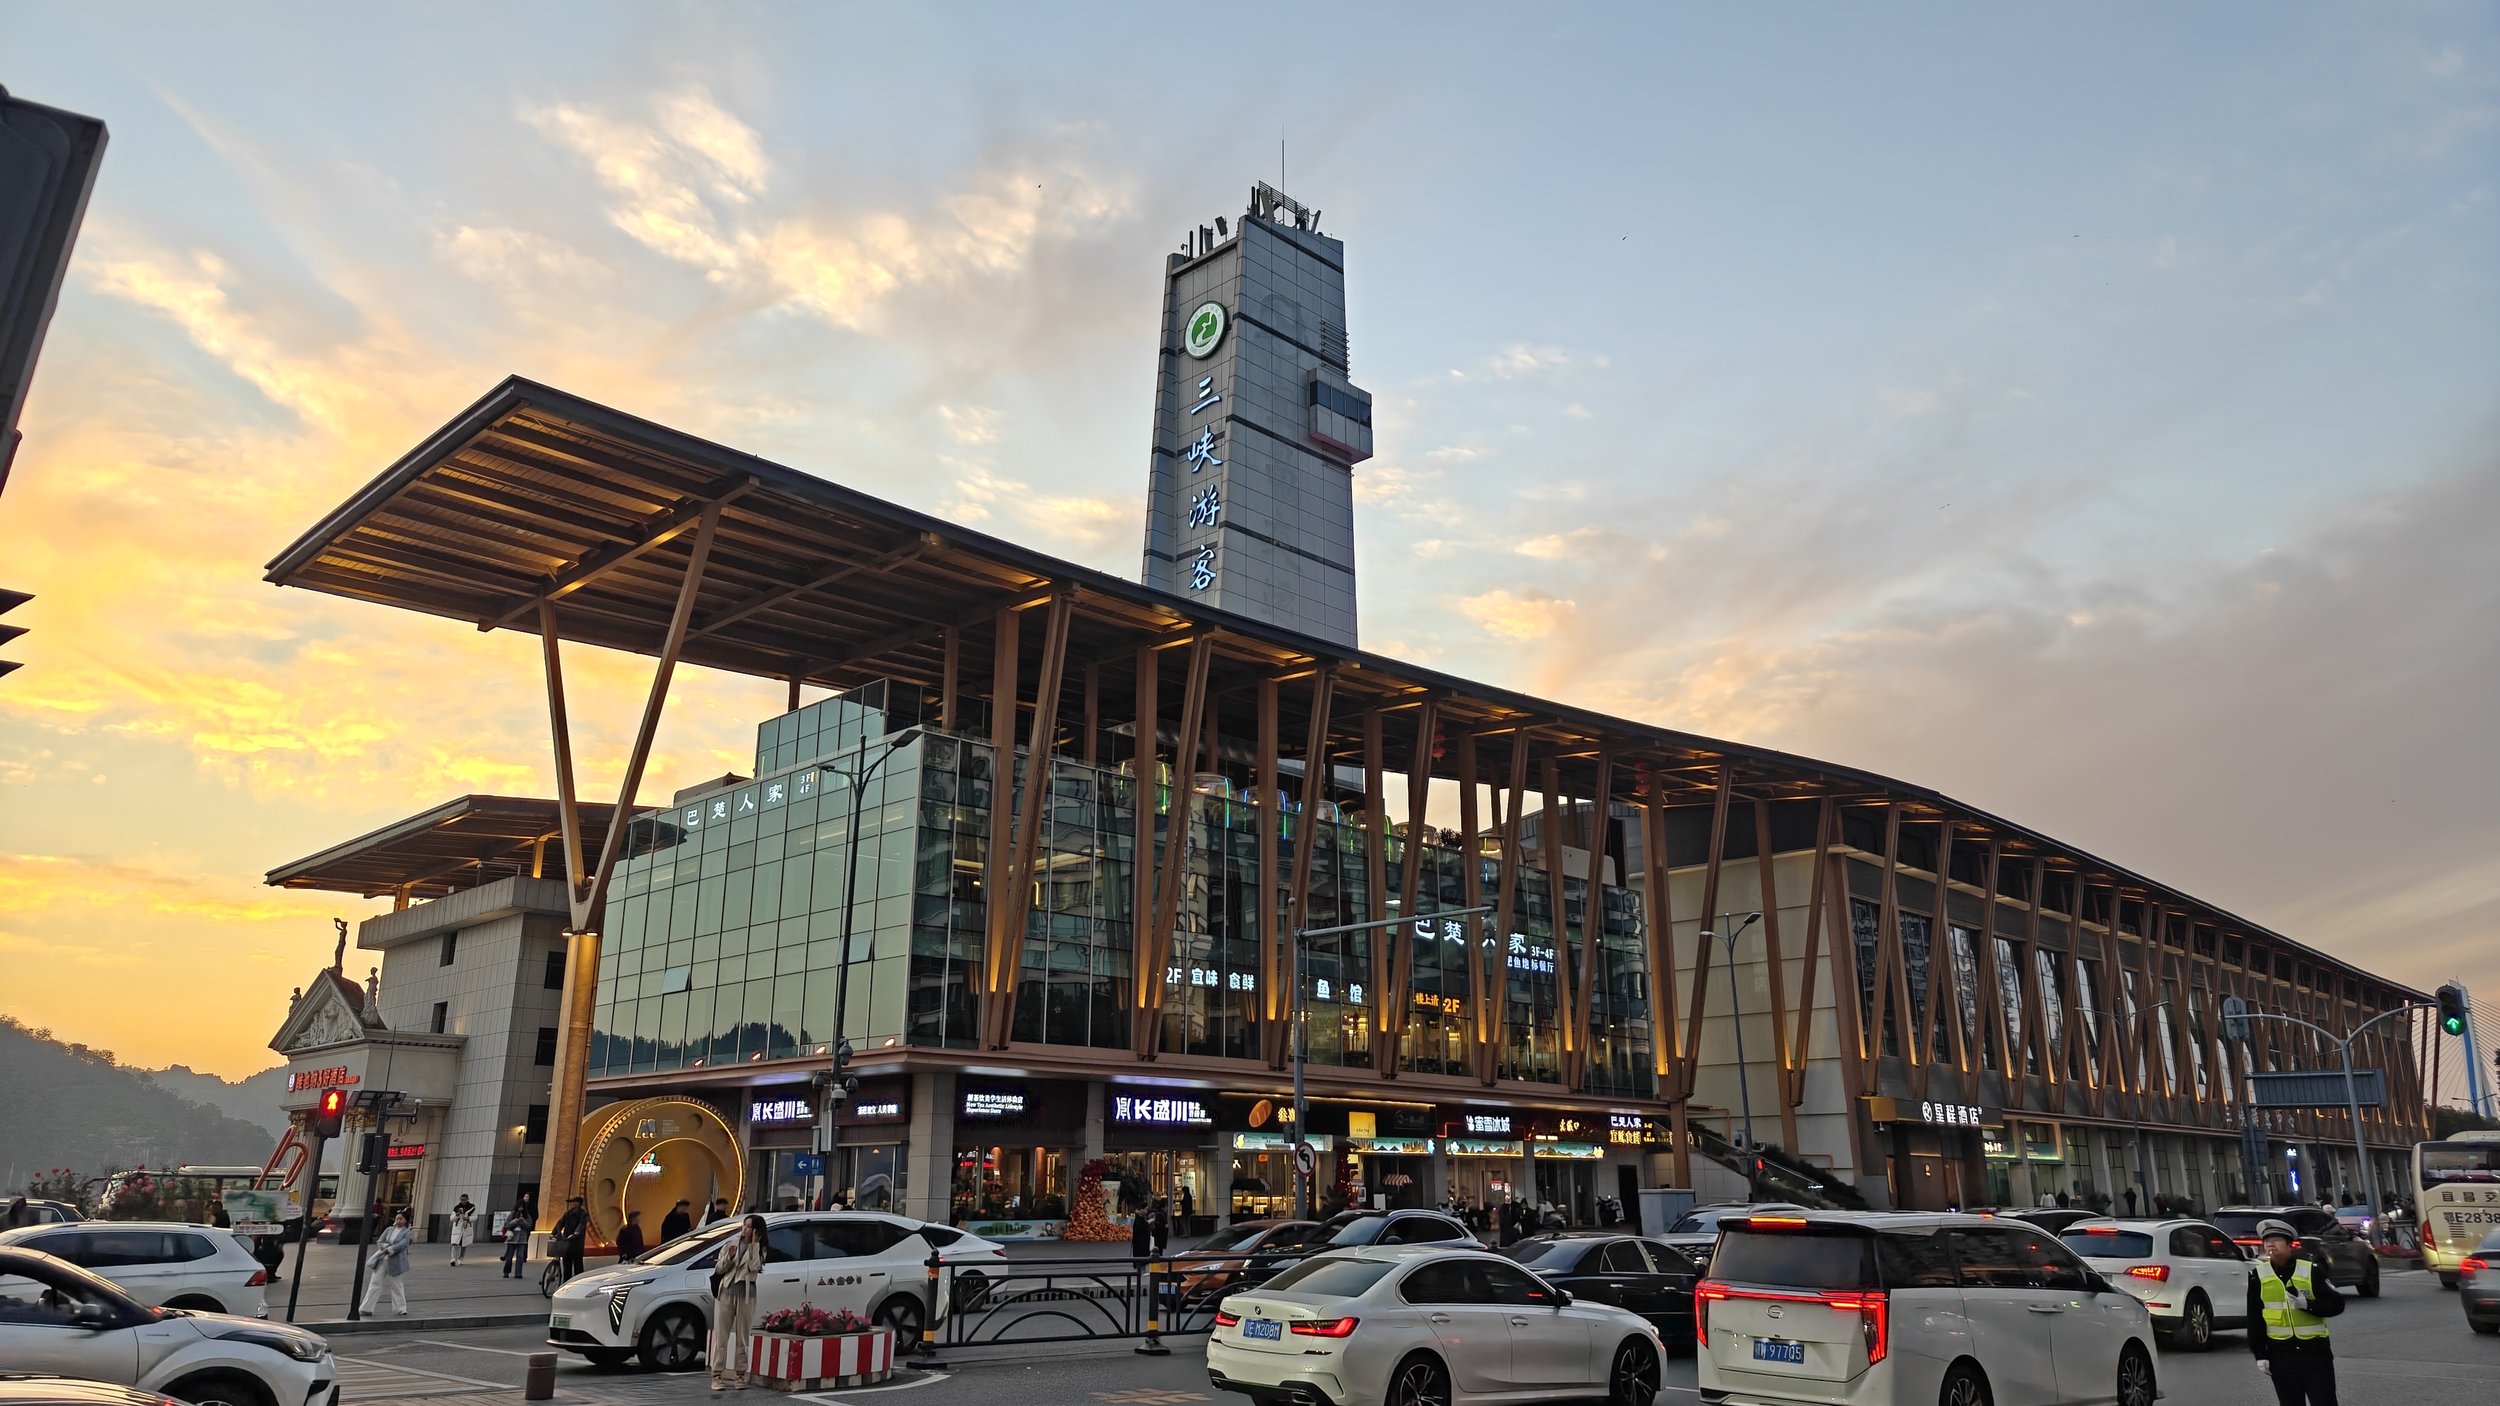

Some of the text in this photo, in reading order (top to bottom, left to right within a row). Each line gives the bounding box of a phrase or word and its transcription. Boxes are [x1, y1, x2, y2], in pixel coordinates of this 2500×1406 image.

[1187, 376, 1223, 590] 三峡游客
[686, 783, 784, 826] 巴楚人家
[1530, 945, 1555, 960] 3F-4F
[1165, 966, 1183, 984] 2F
[1444, 997, 1461, 1014] 2F
[762, 1100, 796, 1120] 长盛川
[1134, 1098, 1188, 1122] 长盛川
[1933, 1102, 1980, 1126] 星程酒店
